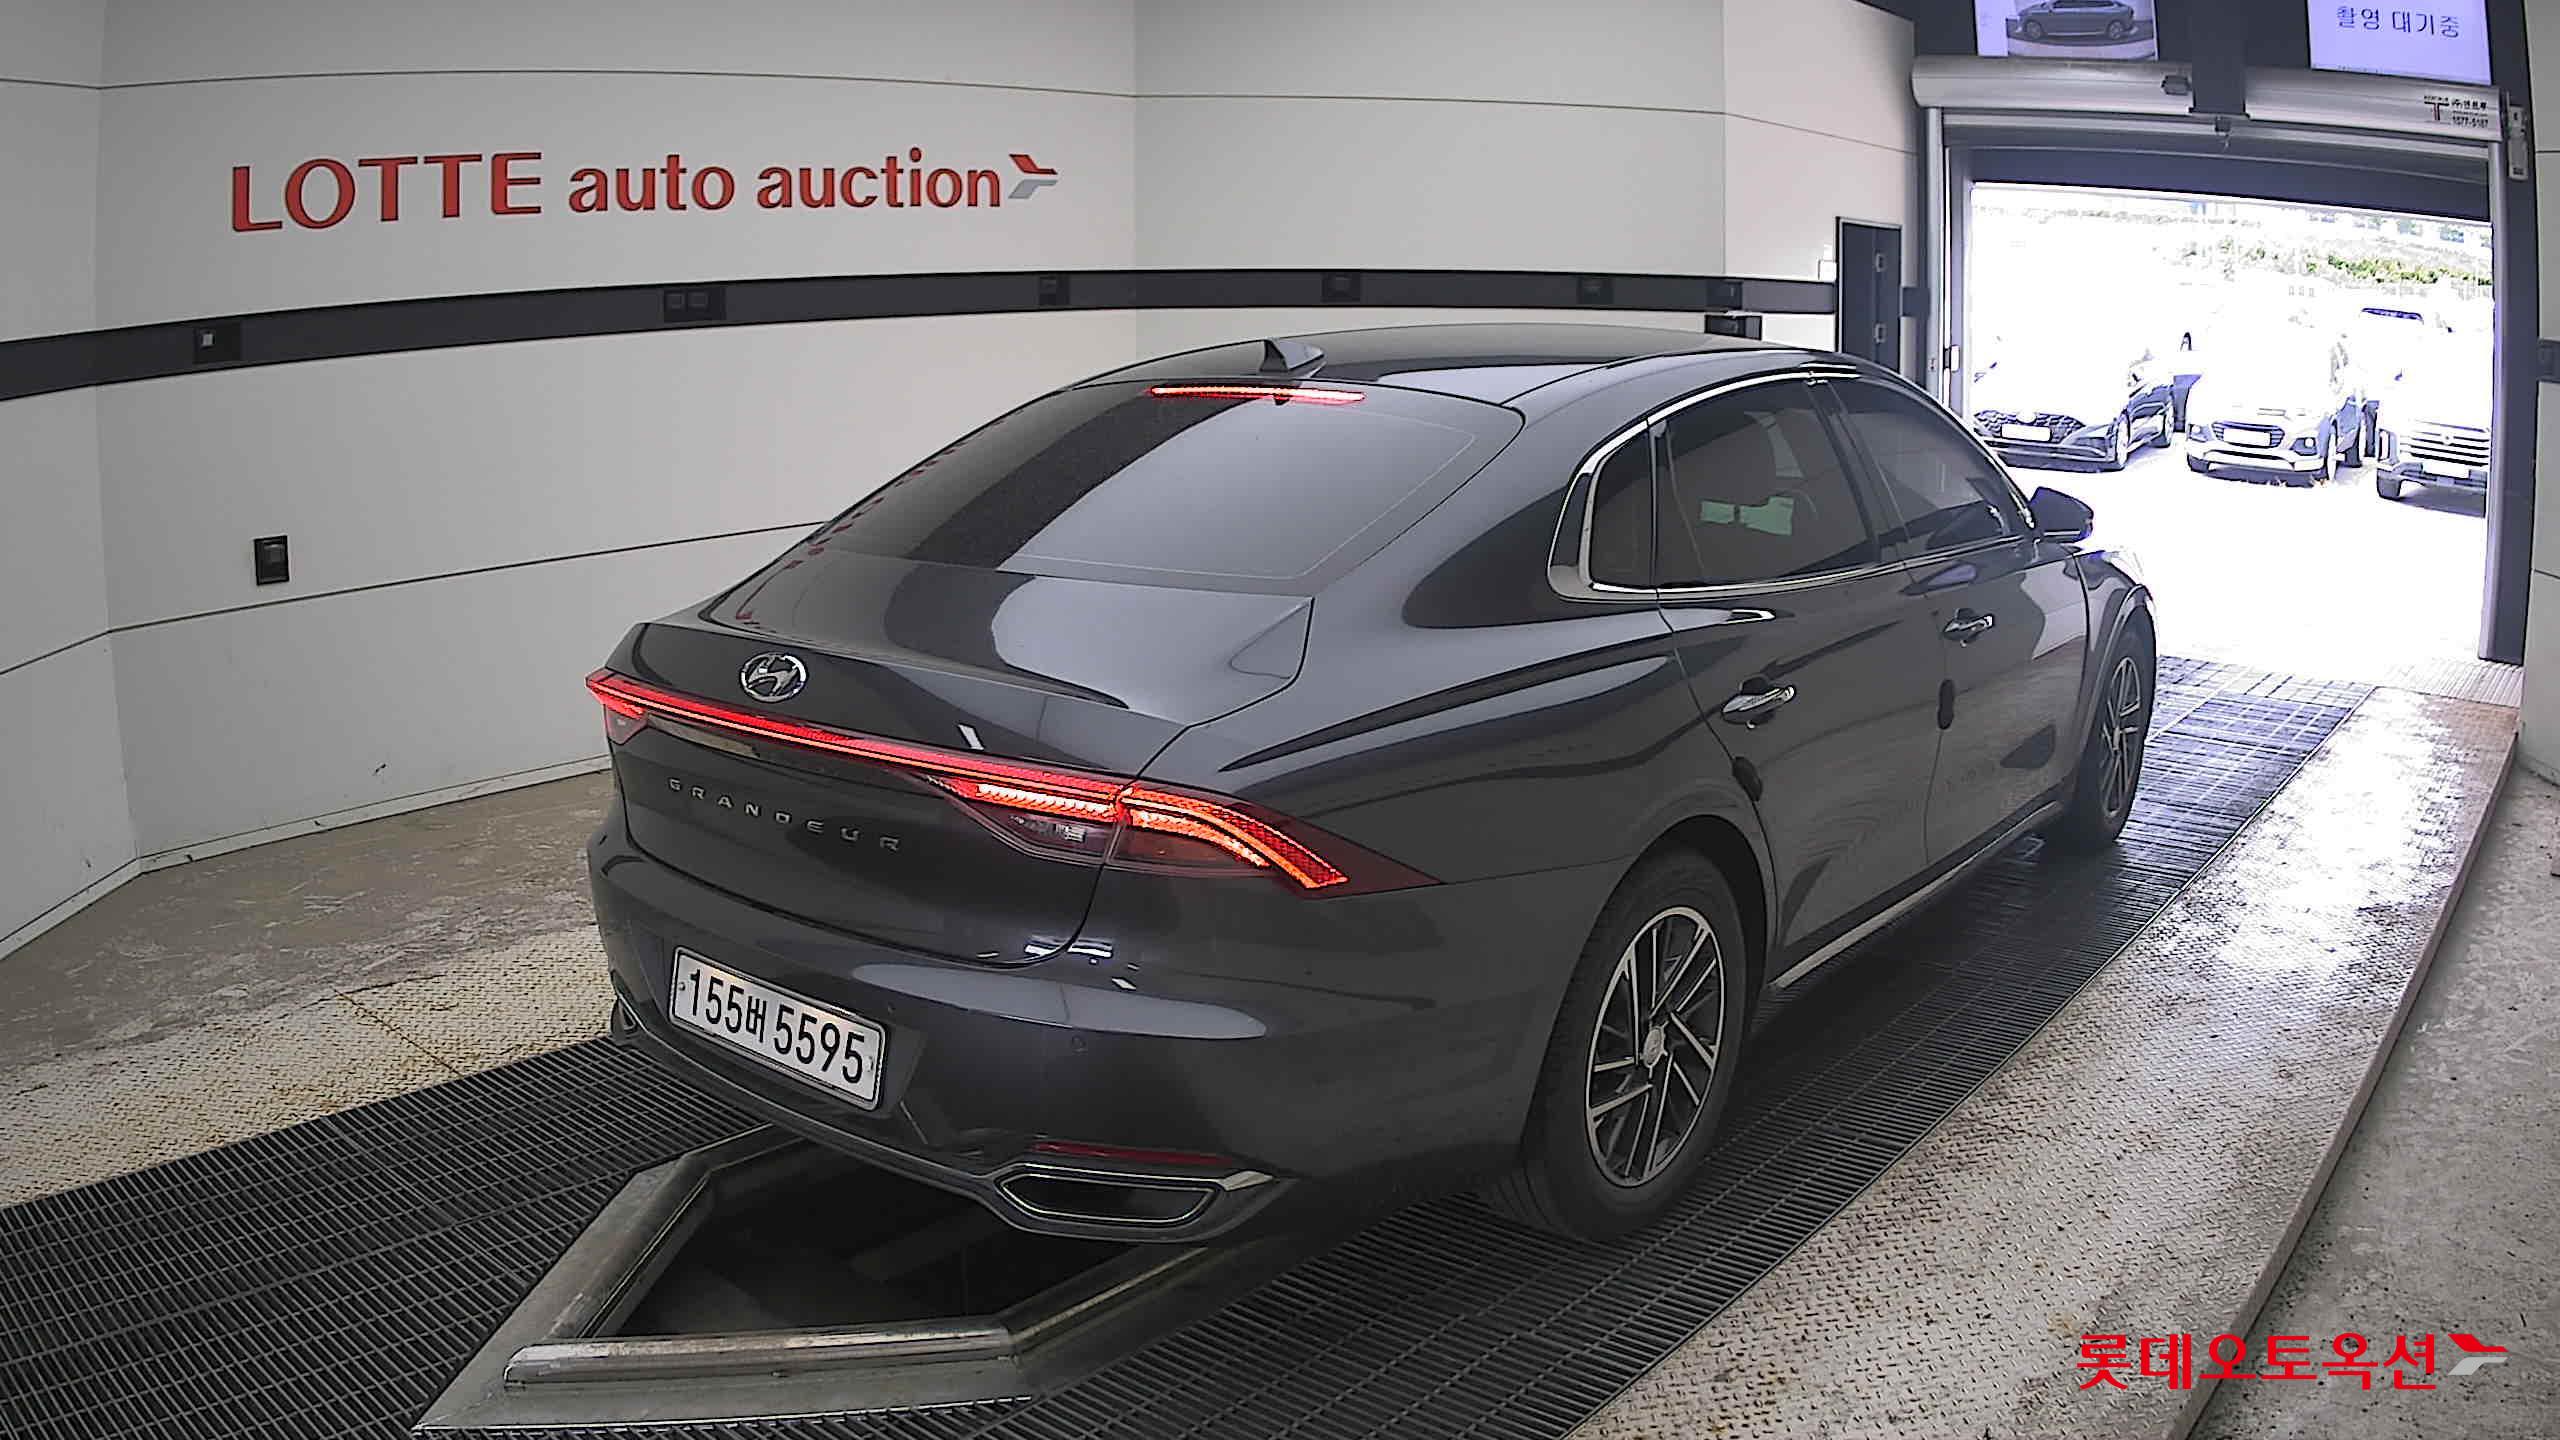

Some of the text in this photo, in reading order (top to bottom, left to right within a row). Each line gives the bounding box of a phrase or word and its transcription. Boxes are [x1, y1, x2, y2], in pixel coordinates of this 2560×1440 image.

[231, 146, 1002, 233] LOTTE auto auction
[668, 777, 901, 852] GRANDEUR
[689, 968, 865, 1084] 155버 5595
